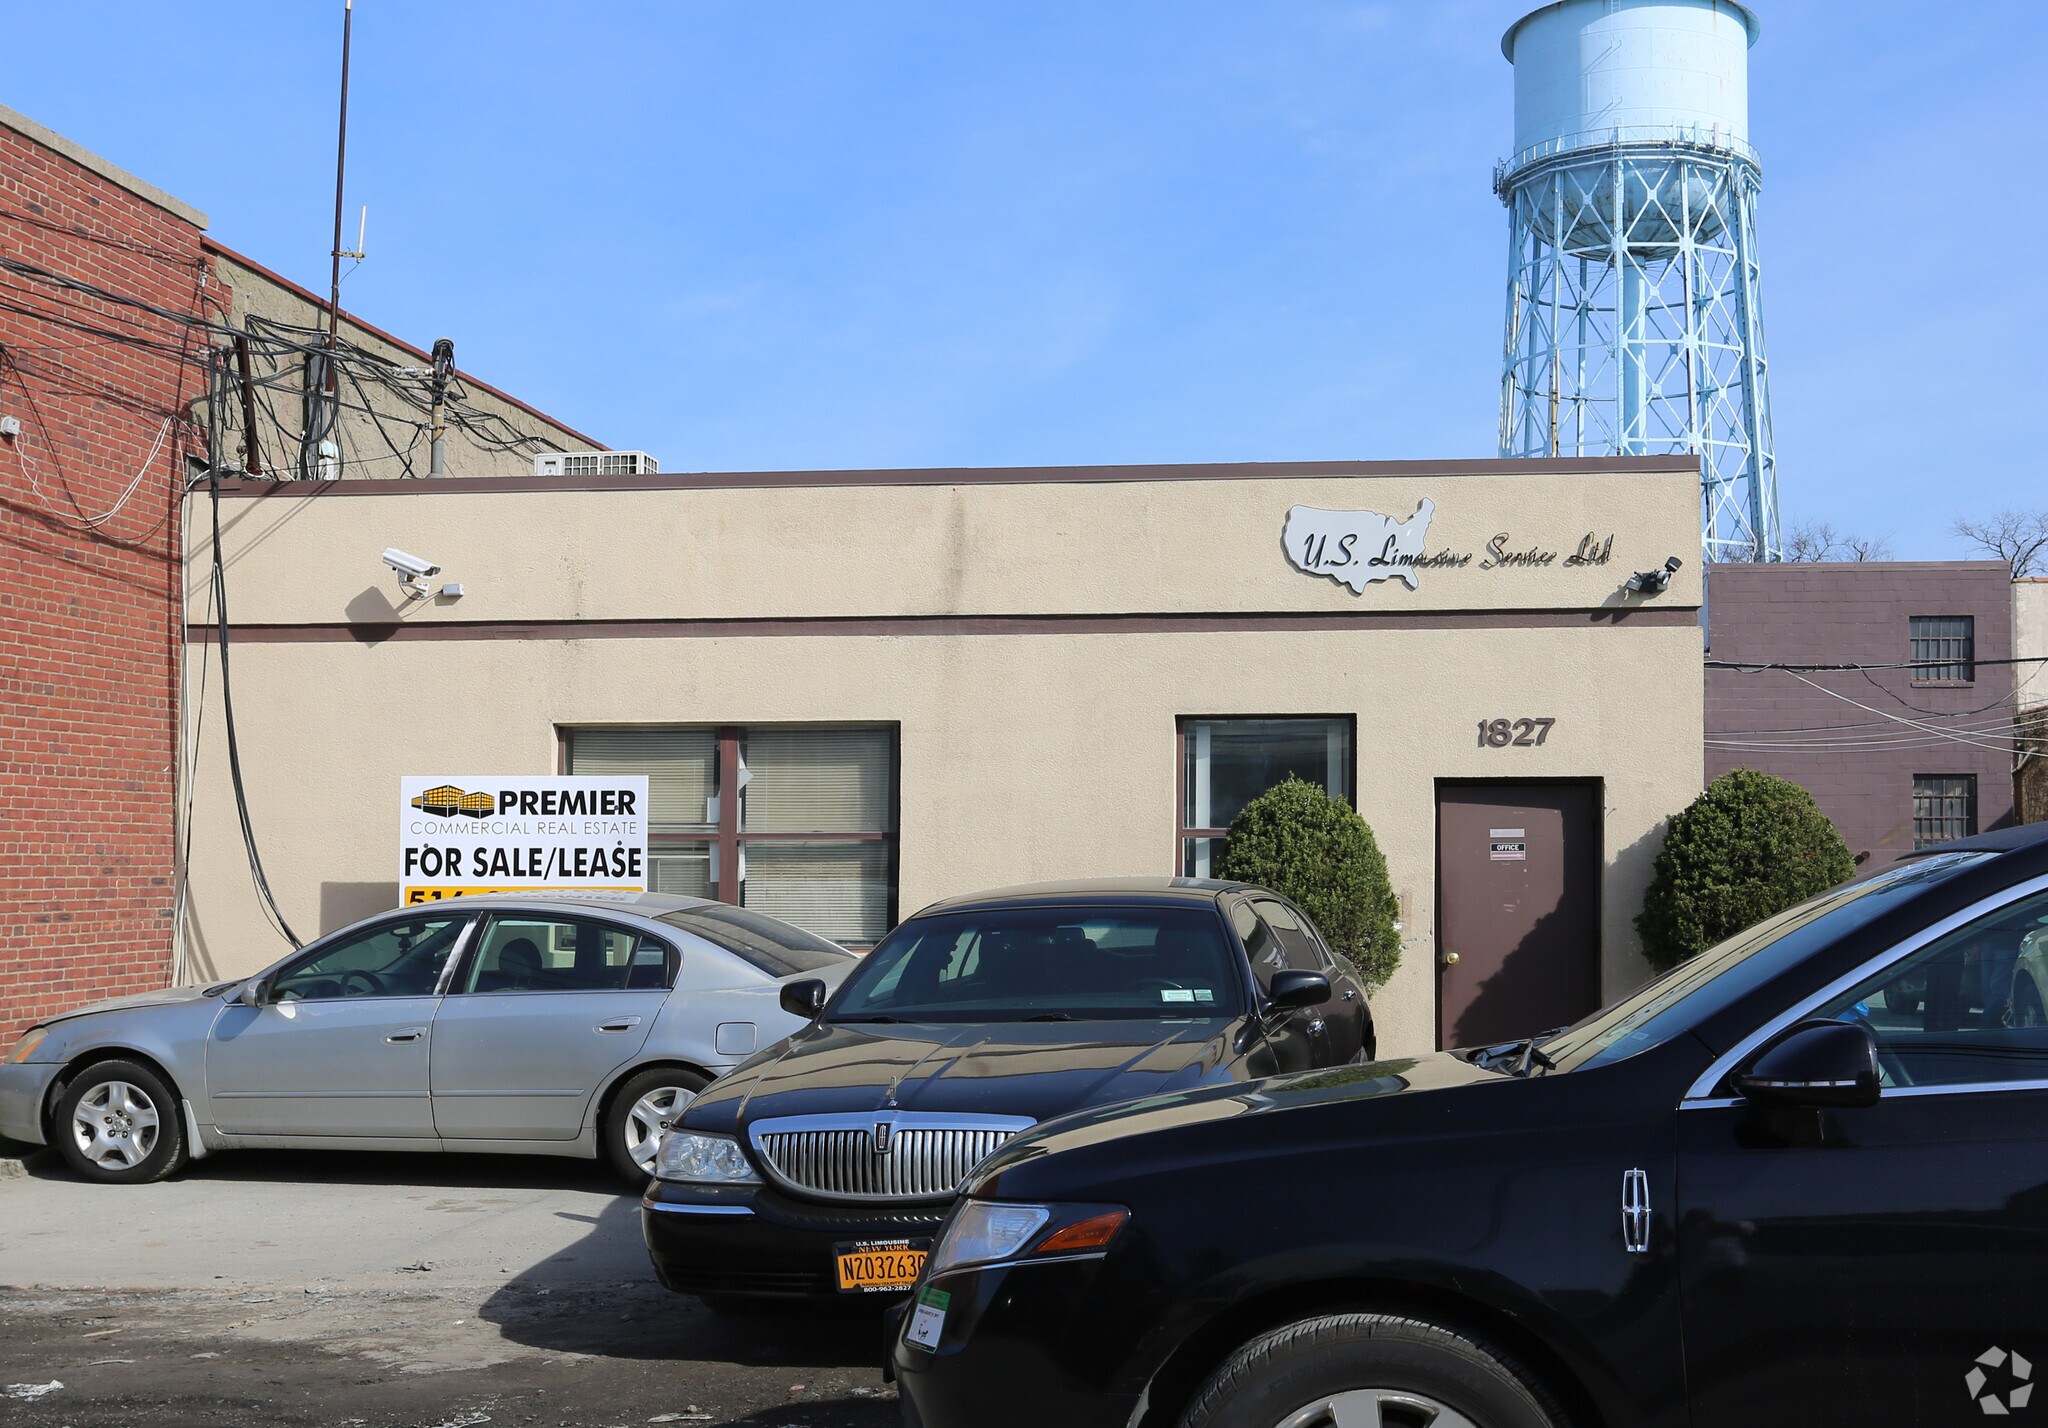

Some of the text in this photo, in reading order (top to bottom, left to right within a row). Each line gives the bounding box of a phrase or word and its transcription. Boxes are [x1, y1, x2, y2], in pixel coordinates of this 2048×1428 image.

[1303, 533, 1359, 568] U.S.
[1480, 531, 1558, 569] Service
[1565, 531, 1615, 566] Ltd
[1477, 717, 1556, 748] 1827
[499, 790, 636, 816] PREMIER
[410, 821, 637, 835] COMMERCIAL REAL ESTATE
[404, 846, 642, 880] FOR SALE/LEASE
